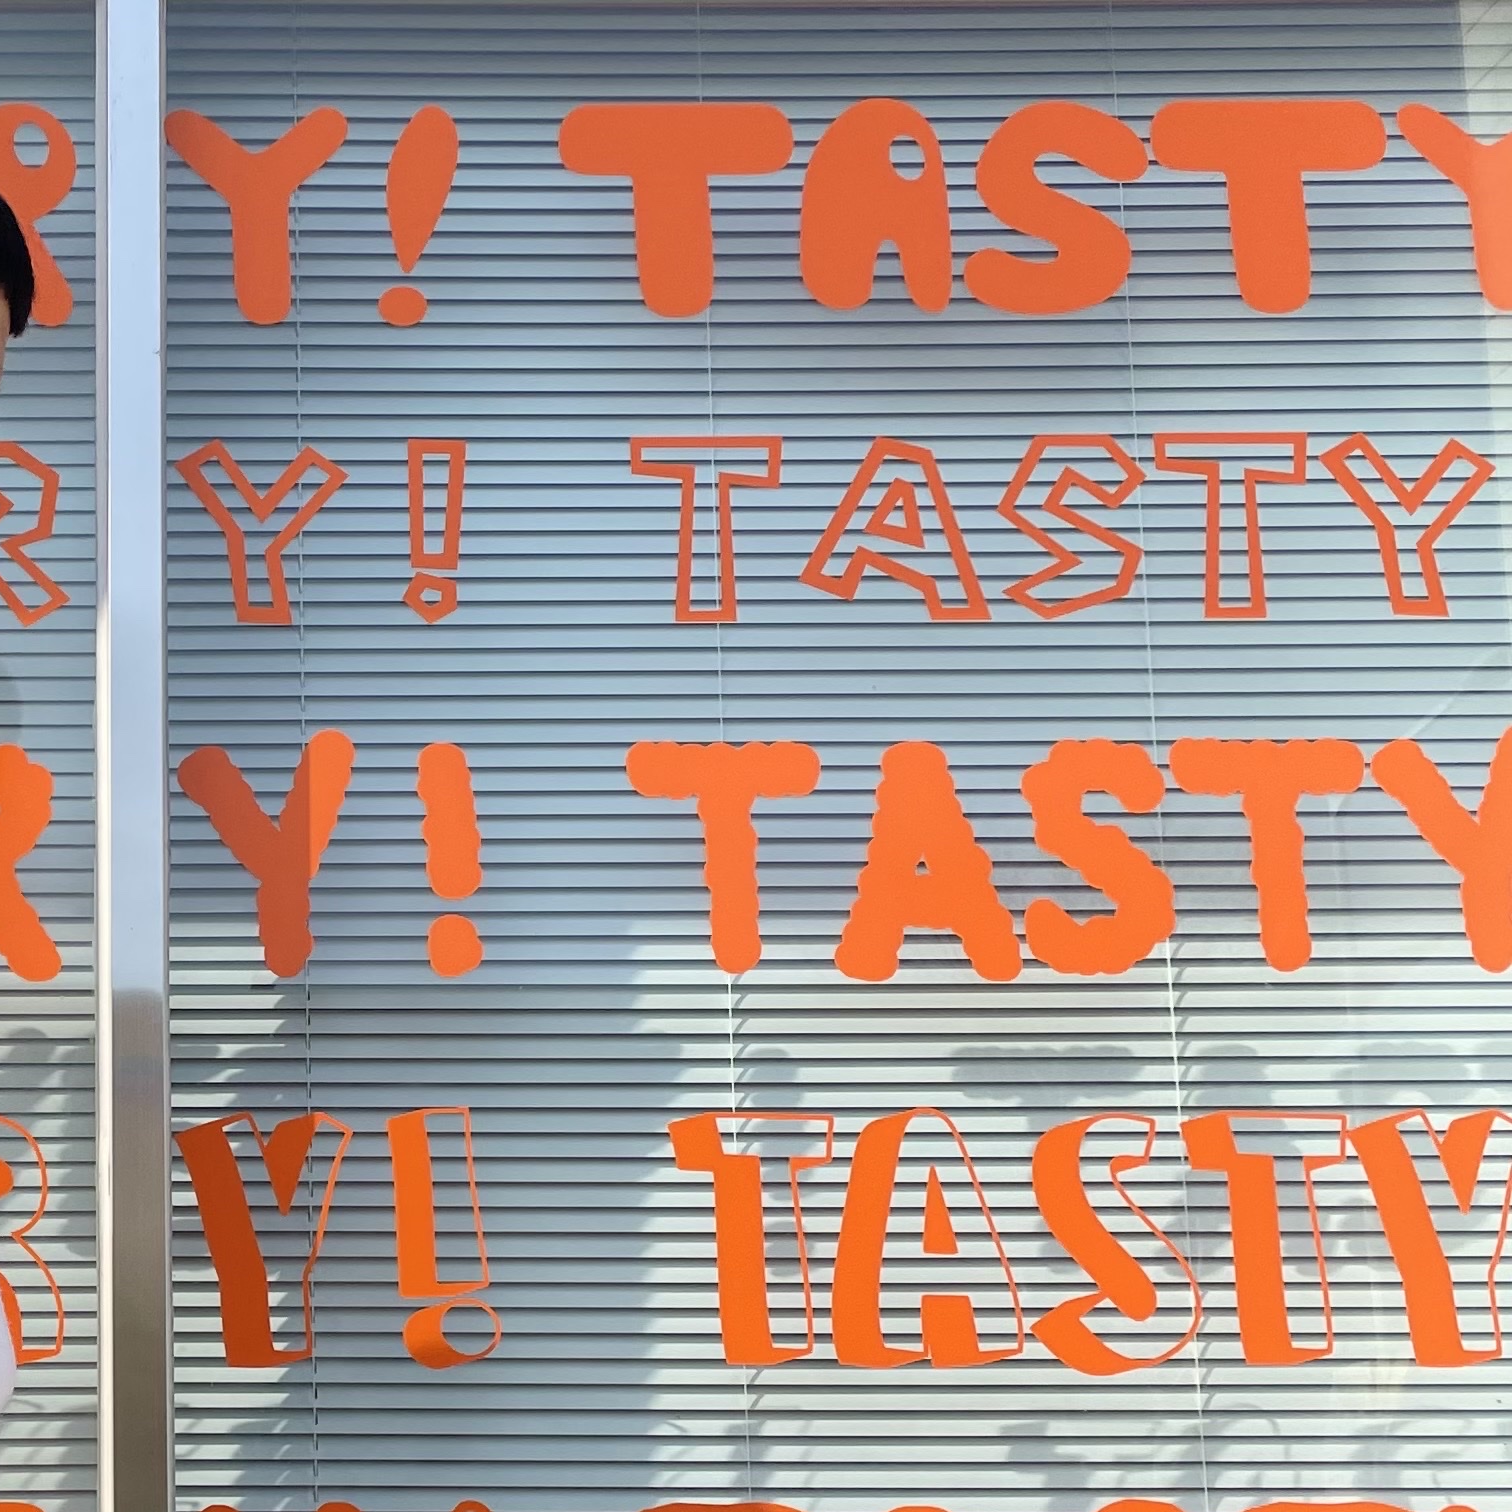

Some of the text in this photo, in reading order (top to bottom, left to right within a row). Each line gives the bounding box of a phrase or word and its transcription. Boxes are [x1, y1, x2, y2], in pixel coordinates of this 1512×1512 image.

[558, 97, 1512, 318] TASTY
[630, 432, 1496, 623] TASTY
[625, 726, 1512, 982] TASTY
[668, 1106, 1512, 1376] TASTY
